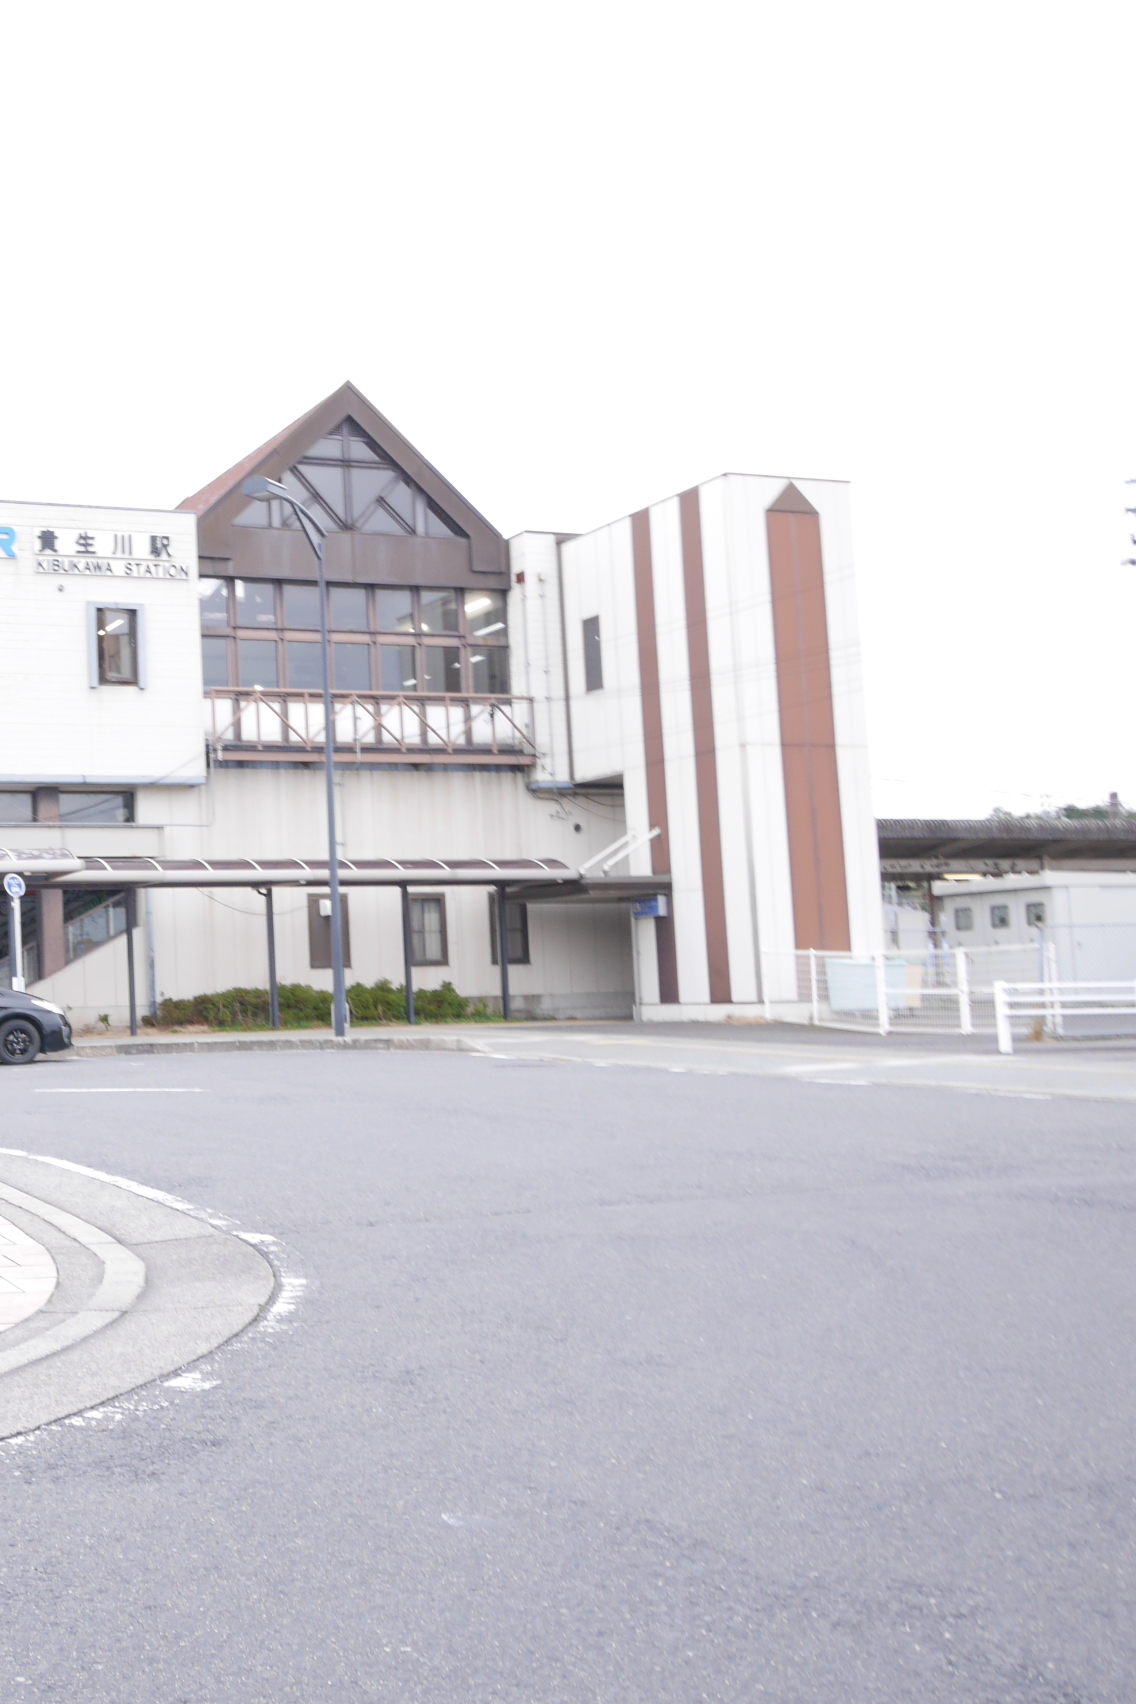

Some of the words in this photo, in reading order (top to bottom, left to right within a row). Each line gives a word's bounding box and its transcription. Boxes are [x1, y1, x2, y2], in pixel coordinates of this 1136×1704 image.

[37, 529, 172, 558] 貴生川駅
[36, 558, 113, 574] KIBUKAWA
[124, 562, 189, 577] STATION
